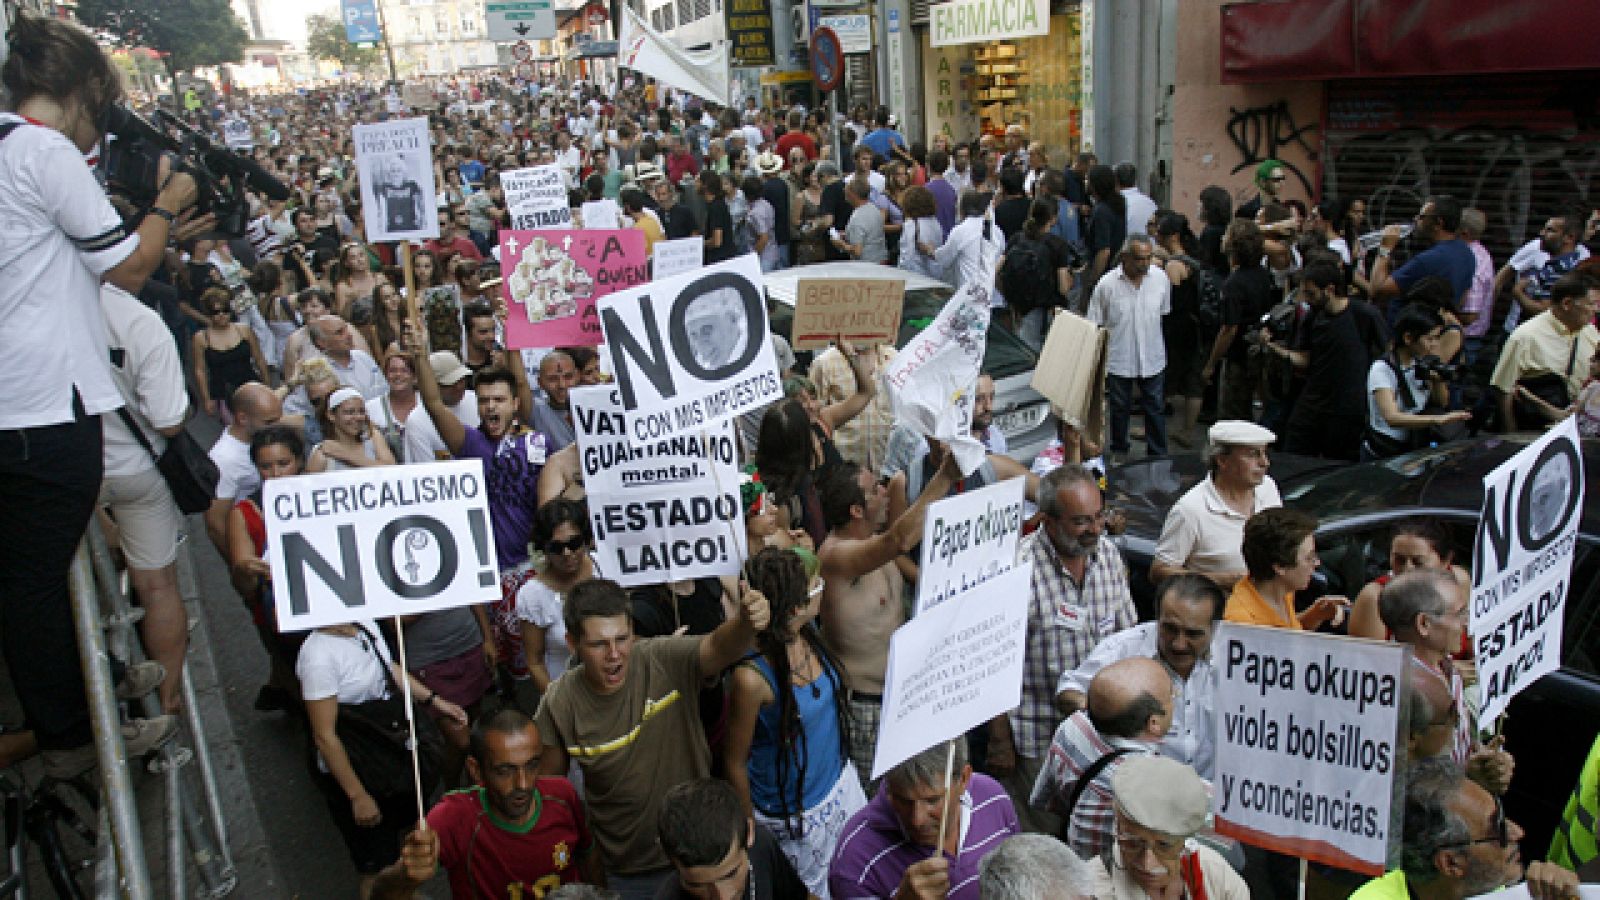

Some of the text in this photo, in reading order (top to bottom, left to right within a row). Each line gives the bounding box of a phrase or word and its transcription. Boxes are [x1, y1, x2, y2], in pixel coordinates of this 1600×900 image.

[937, 0, 1037, 40] FARMACIA
[602, 271, 765, 411] NO
[635, 370, 778, 440] CON MIS IMPUESTOS
[274, 472, 479, 520] CLERICALISMO
[622, 462, 706, 482] mental.
[594, 493, 738, 541] ¡ESTADO
[929, 501, 1020, 567] Papa okupa
[1473, 437, 1580, 588] NO
[279, 507, 496, 616] NO!
[617, 535, 728, 575] LAICO!
[1475, 585, 1500, 618] CON
[1502, 569, 1521, 593] MIS
[1227, 639, 1396, 714] Papa okupa
[1224, 704, 1391, 774] viola bolsillos
[1220, 773, 1383, 840] y conciencias.
